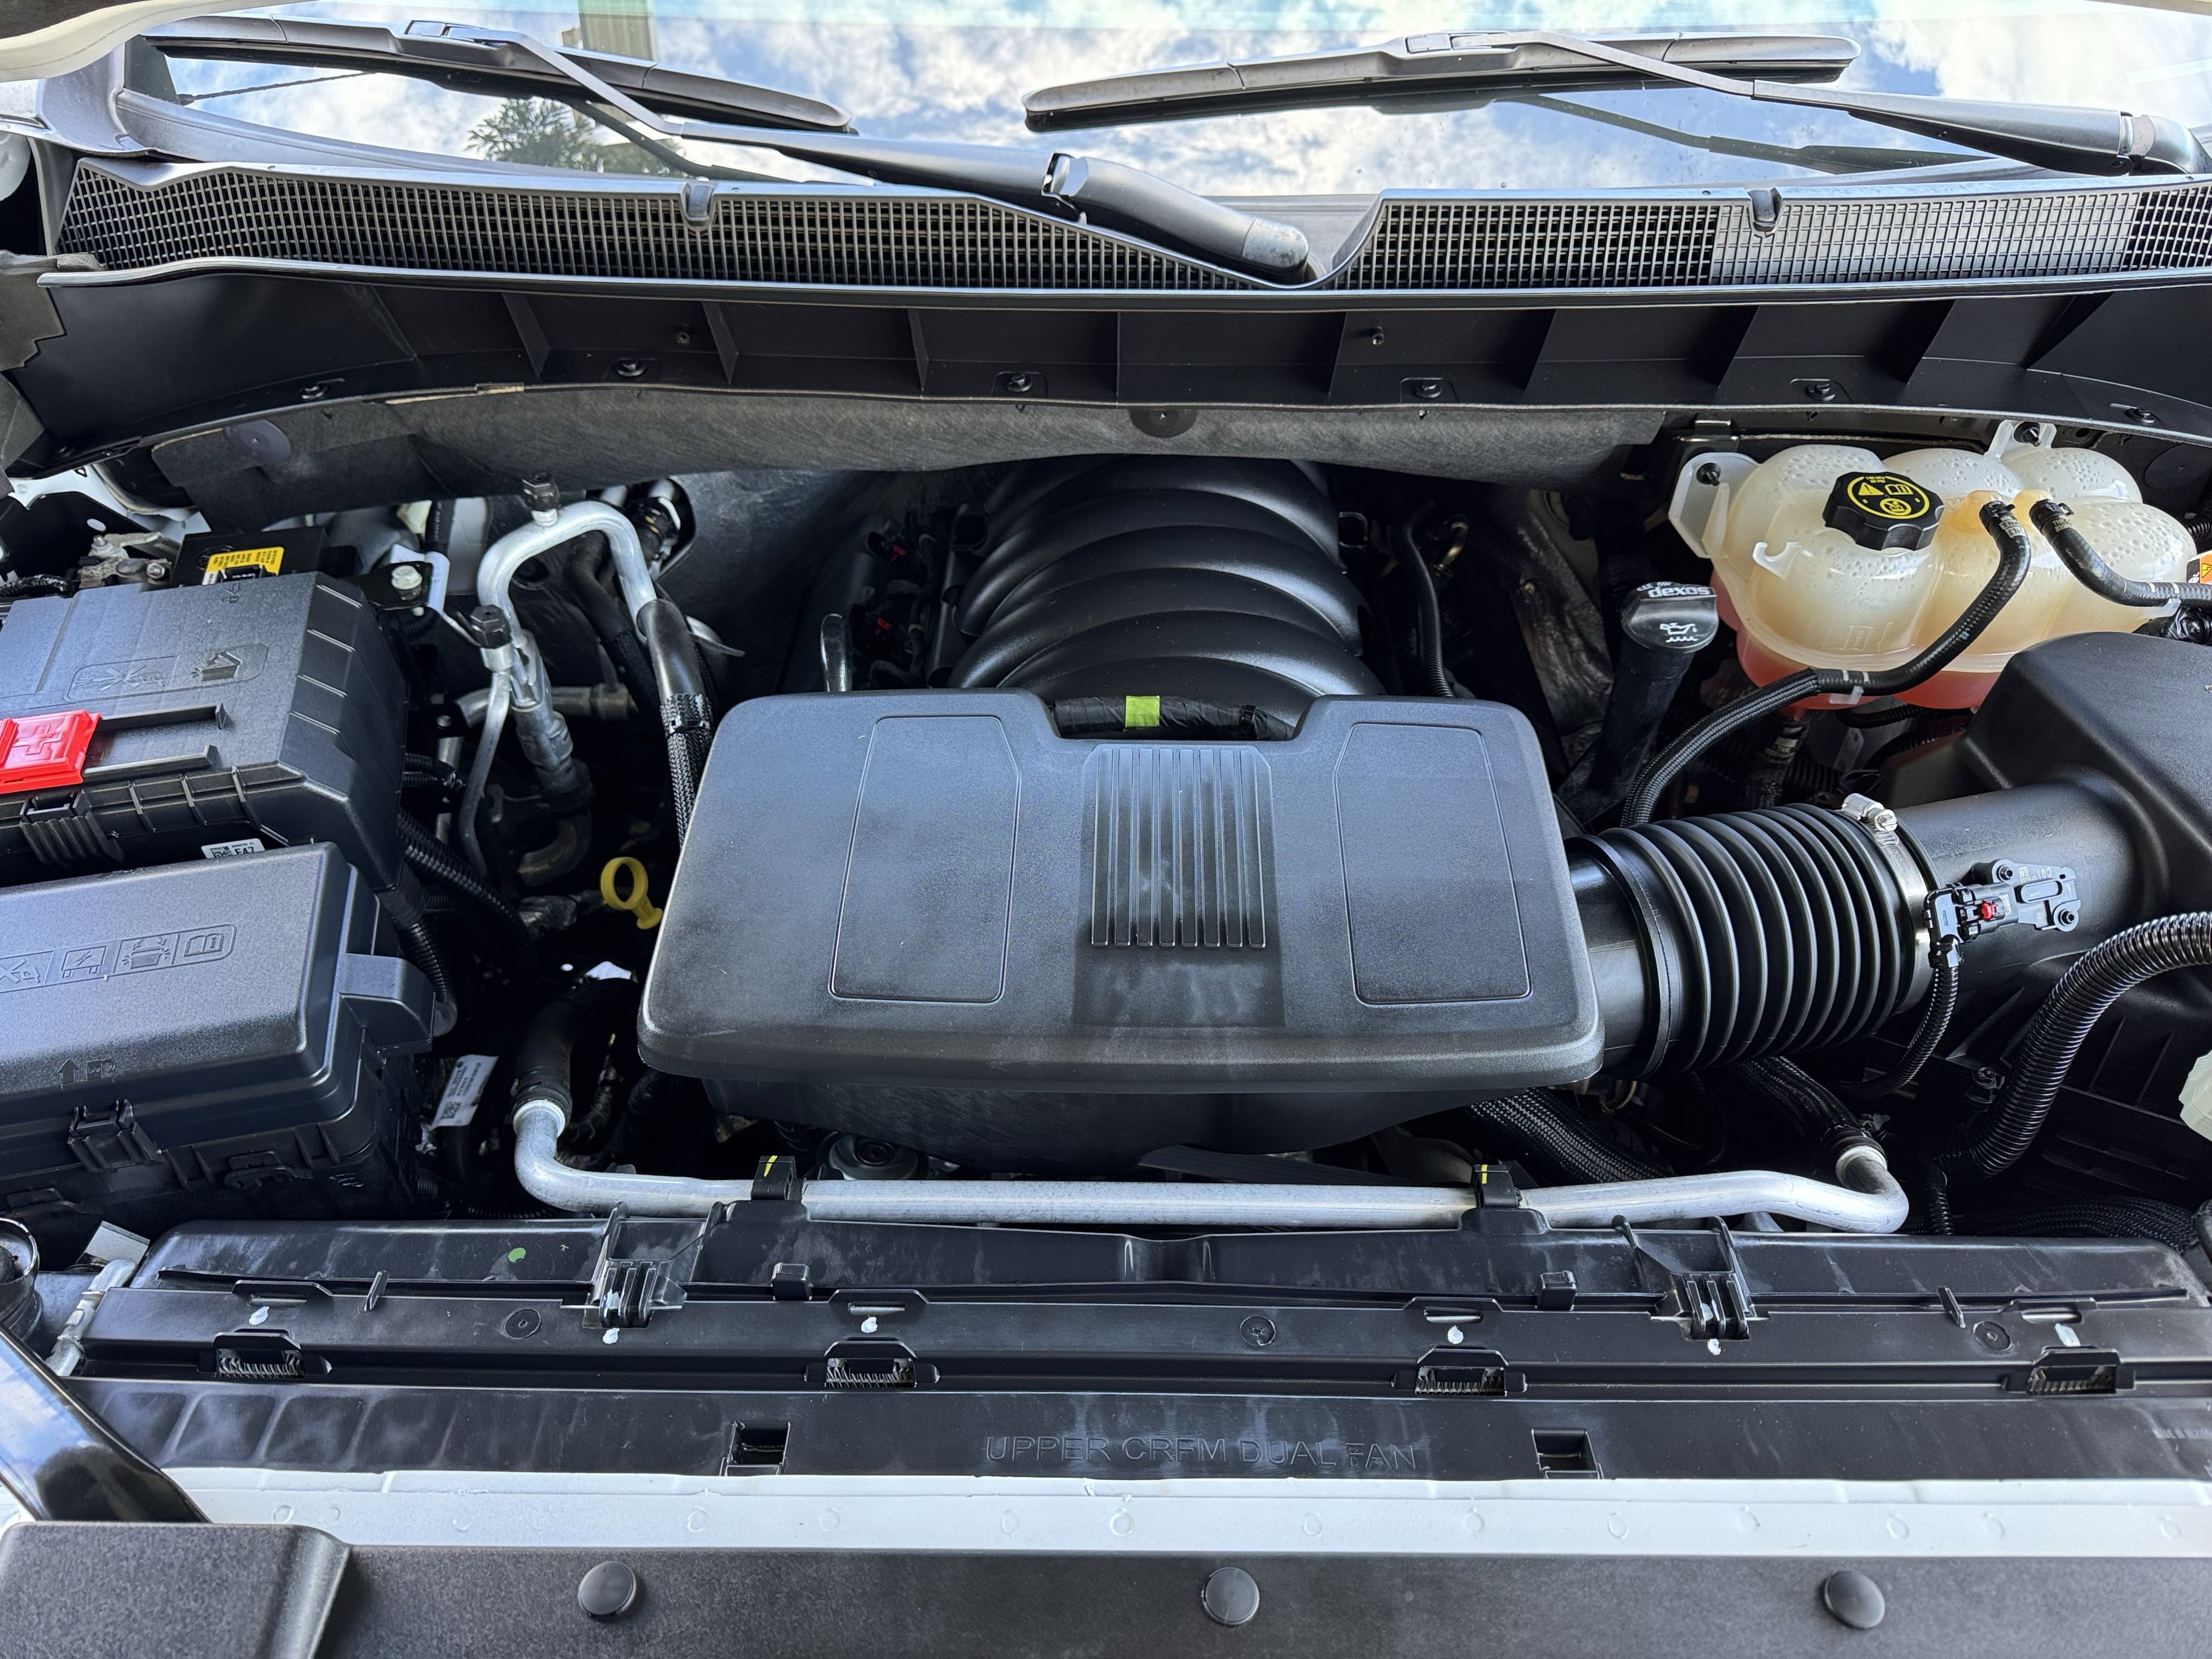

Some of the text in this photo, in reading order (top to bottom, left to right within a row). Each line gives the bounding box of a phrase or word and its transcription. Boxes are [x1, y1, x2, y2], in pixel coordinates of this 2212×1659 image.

[1648, 586, 1711, 597] dexos
[986, 1436, 1416, 1470] UPPER CRFM DUAL FAN
